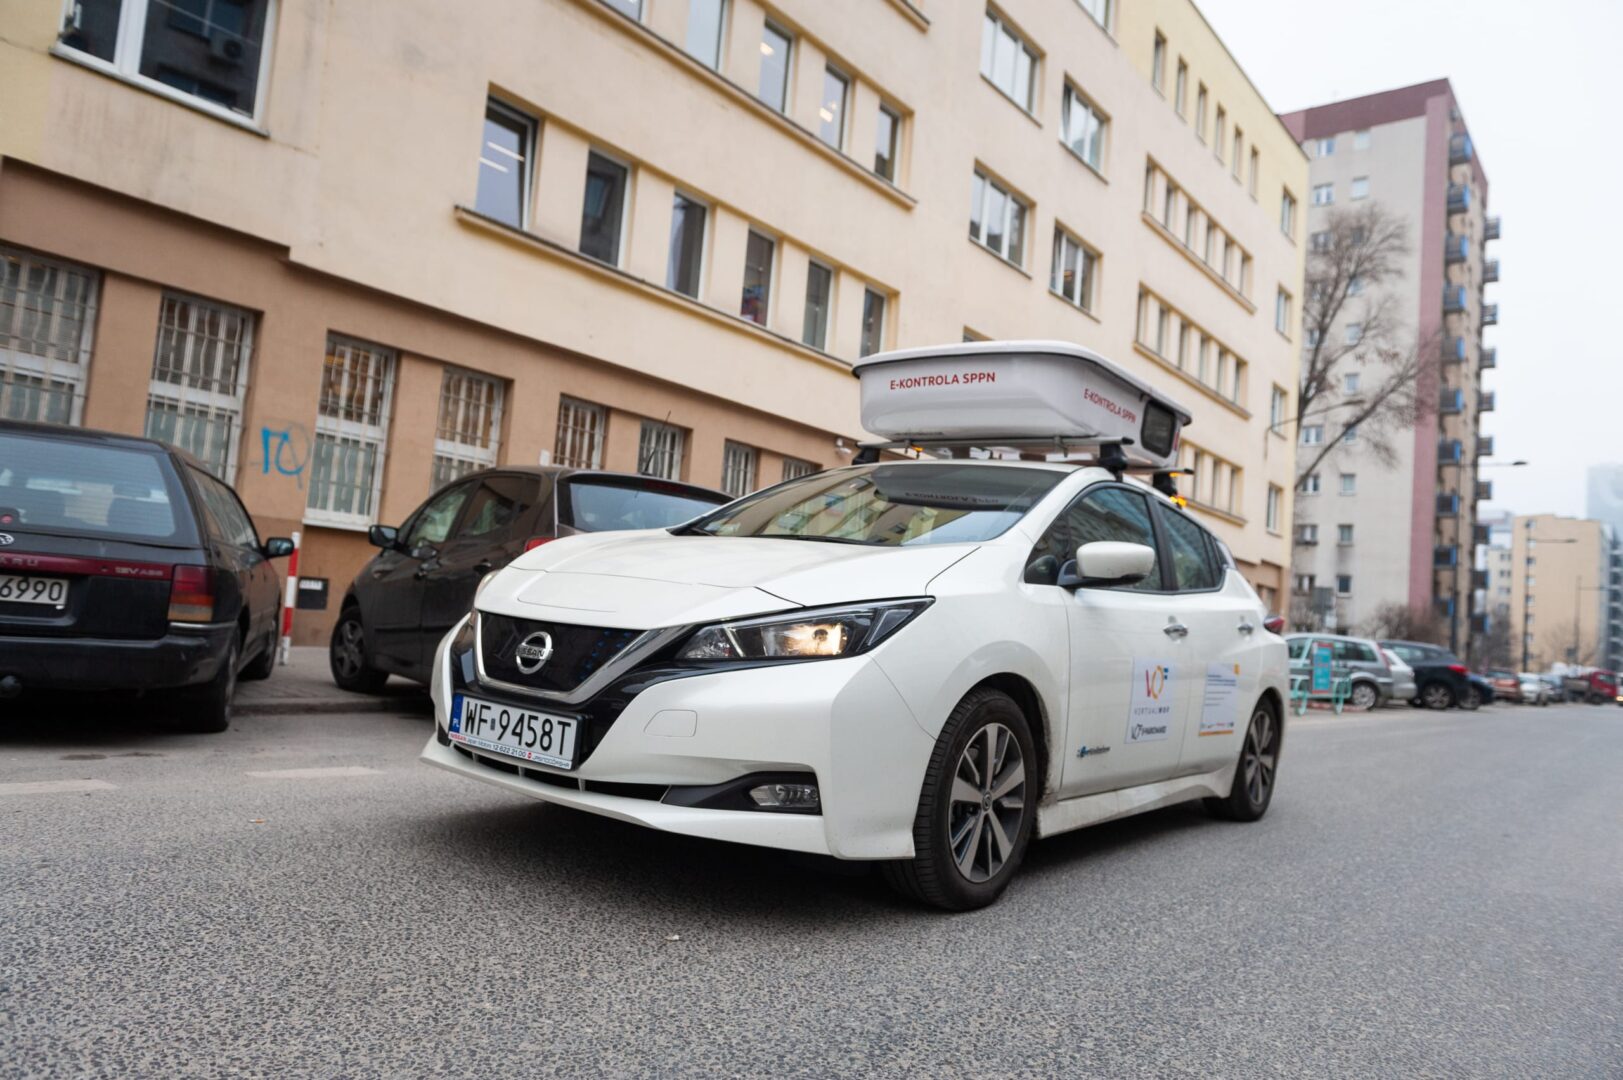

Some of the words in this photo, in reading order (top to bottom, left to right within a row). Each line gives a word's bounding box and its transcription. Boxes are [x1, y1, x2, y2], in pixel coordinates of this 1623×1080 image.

[890, 373, 959, 390] E-KONTROLA
[963, 371, 996, 384] SPPN
[1084, 388, 1121, 416] E-KONTROLA
[1122, 407, 1137, 424] SPPN
[0, 577, 63, 602] 6990
[452, 717, 460, 728] PL
[464, 700, 491, 736] WF
[497, 709, 571, 756] 9458T
